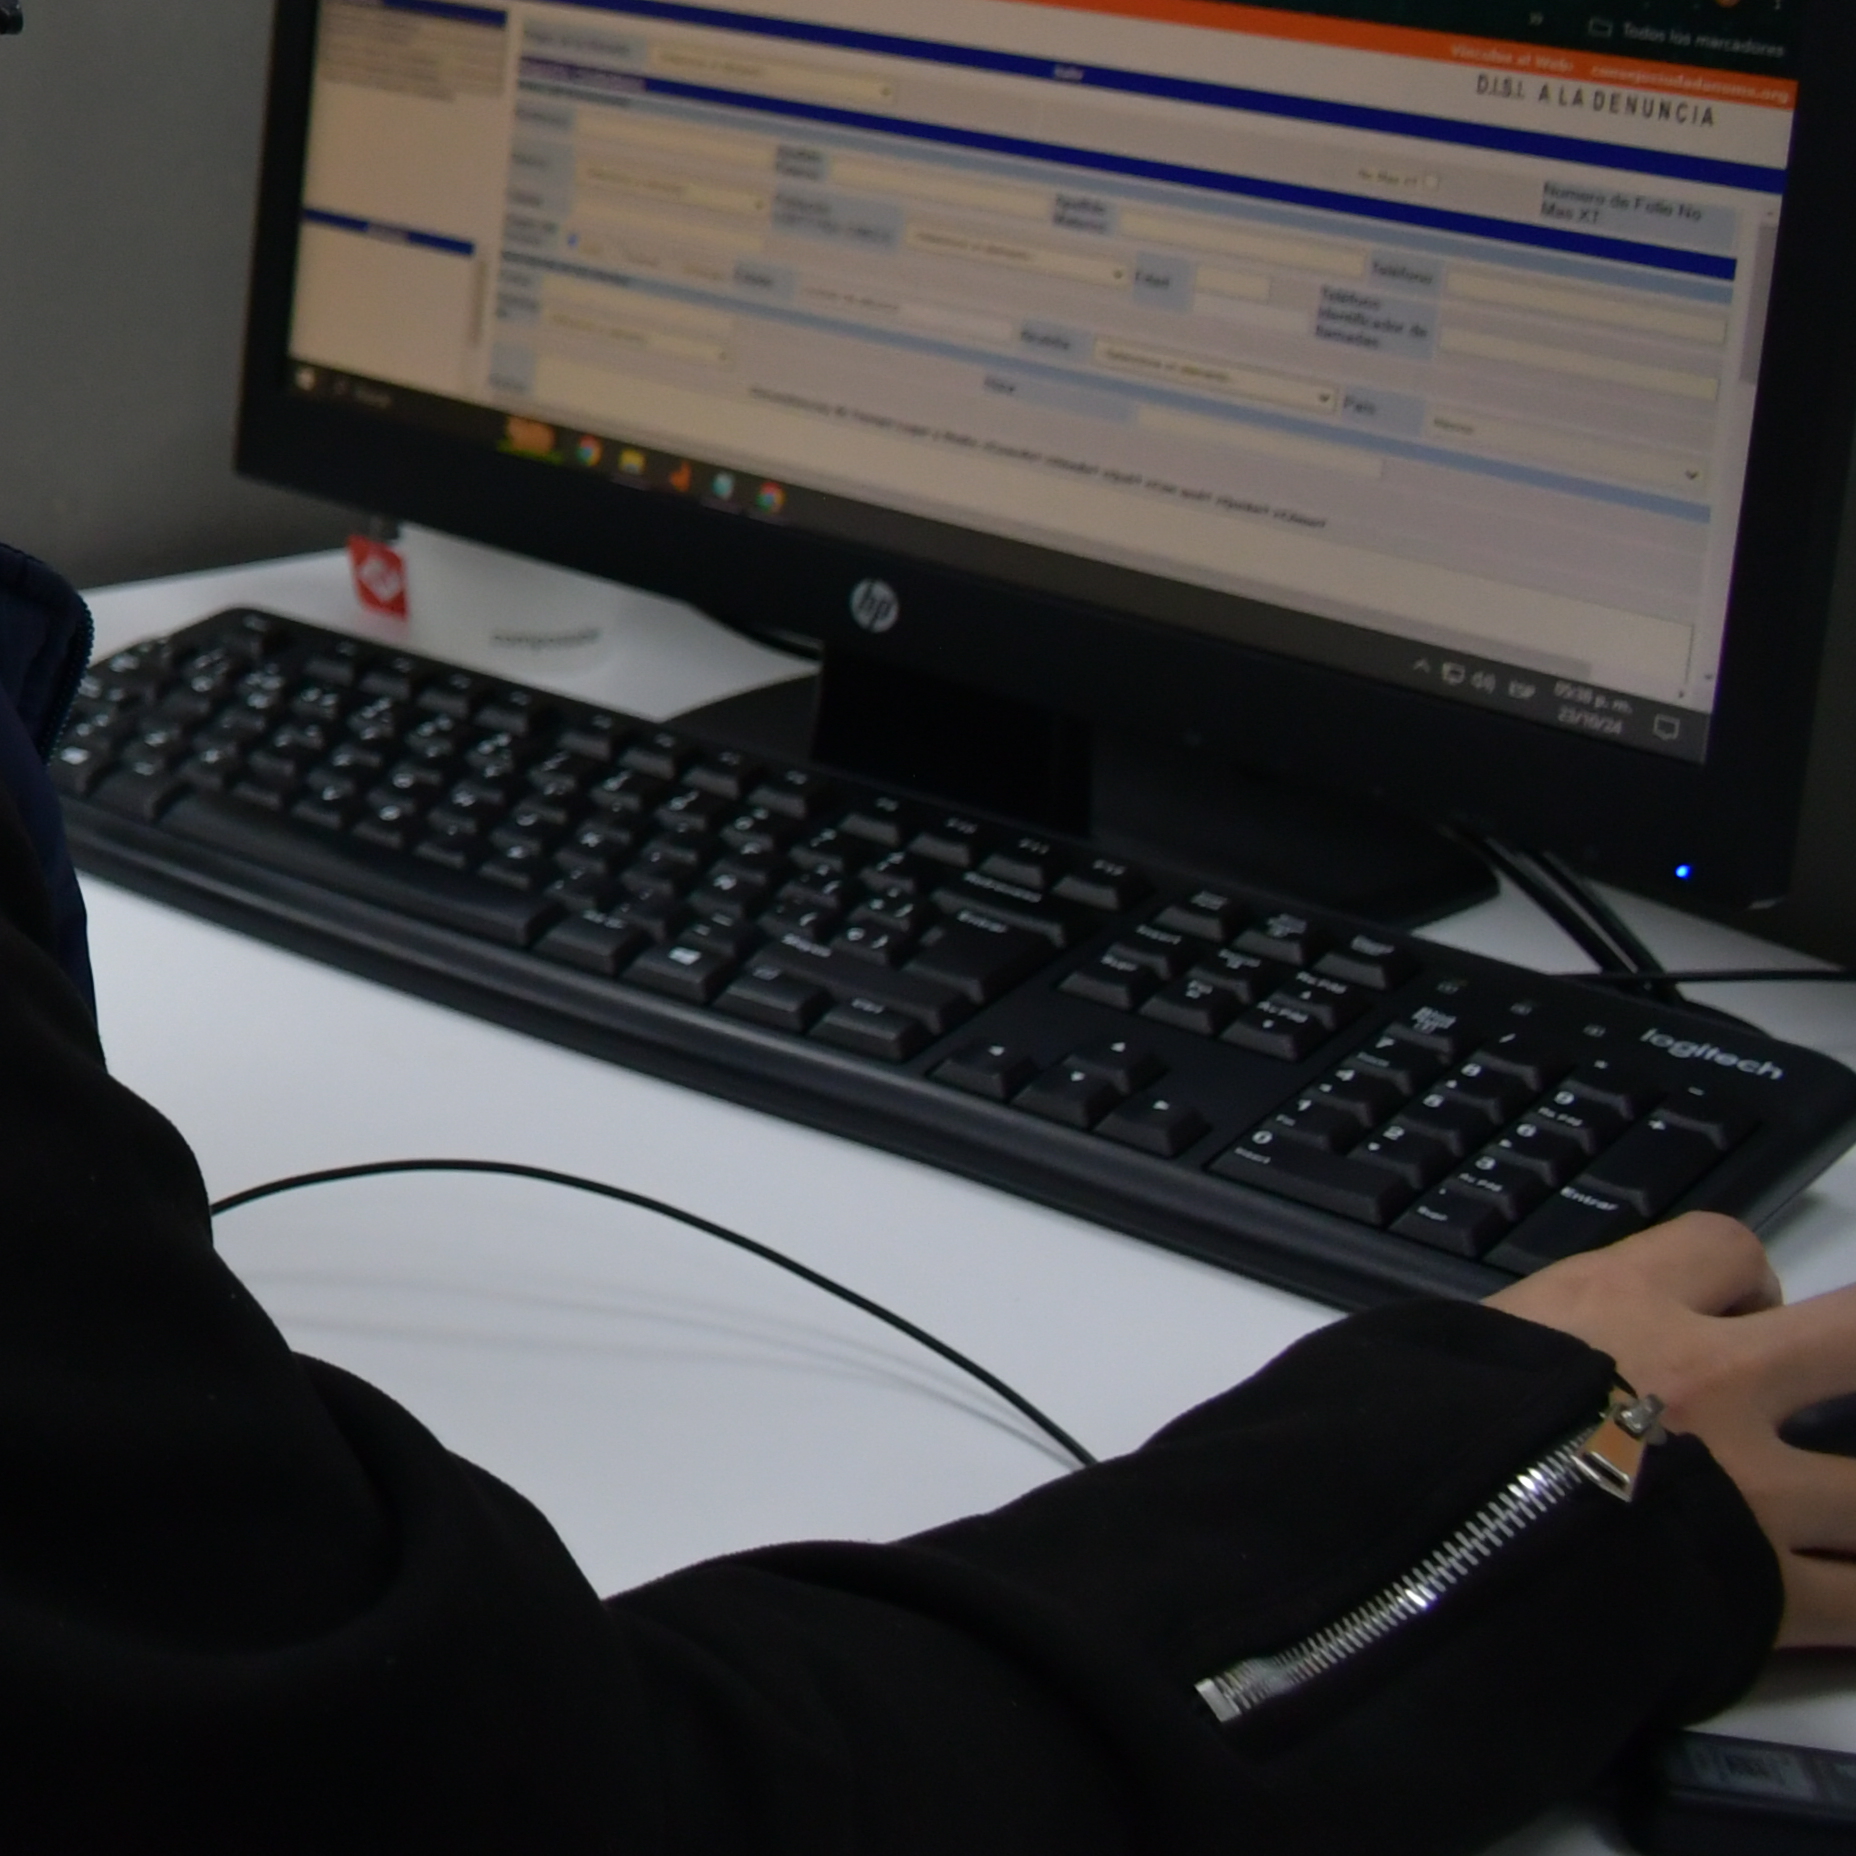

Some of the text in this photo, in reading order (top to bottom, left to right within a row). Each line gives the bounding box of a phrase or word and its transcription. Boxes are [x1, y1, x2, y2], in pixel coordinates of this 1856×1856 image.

[1537, 80, 1551, 103] A
[1558, 83, 1585, 108] LA
[1592, 91, 1715, 128] DENUNCIA
[855, 578, 895, 632] hp
[1640, 1028, 1783, 1081] logitech
[1560, 1186, 1618, 1211] Entrar
